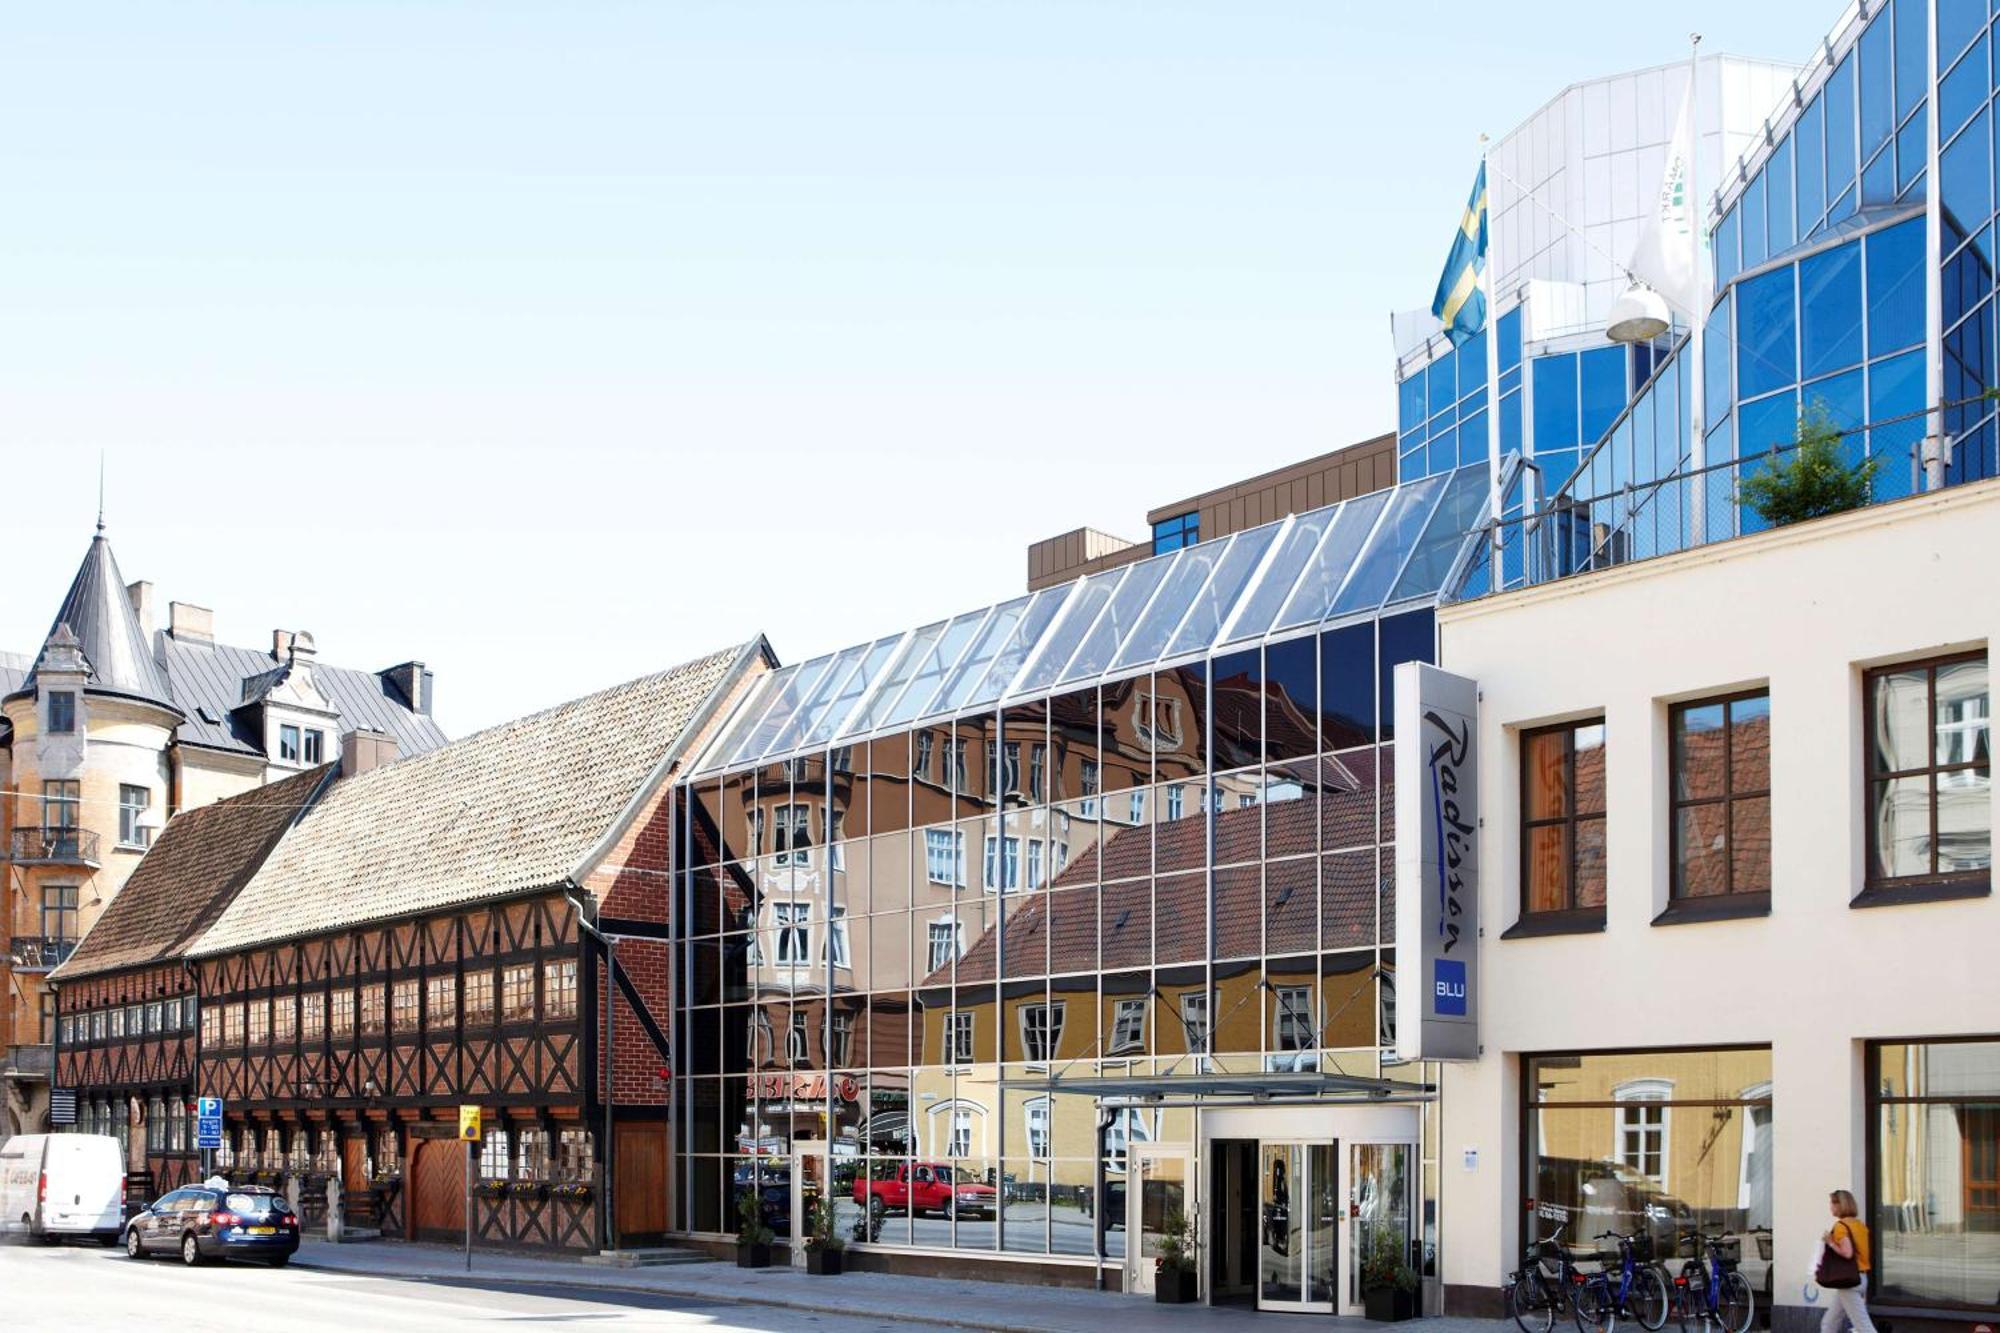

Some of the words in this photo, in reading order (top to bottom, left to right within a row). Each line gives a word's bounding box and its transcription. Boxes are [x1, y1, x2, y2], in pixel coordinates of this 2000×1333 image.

[1424, 710, 1475, 954] Radisson
[1436, 981, 1465, 998] BLU
[205, 1100, 217, 1116] P
